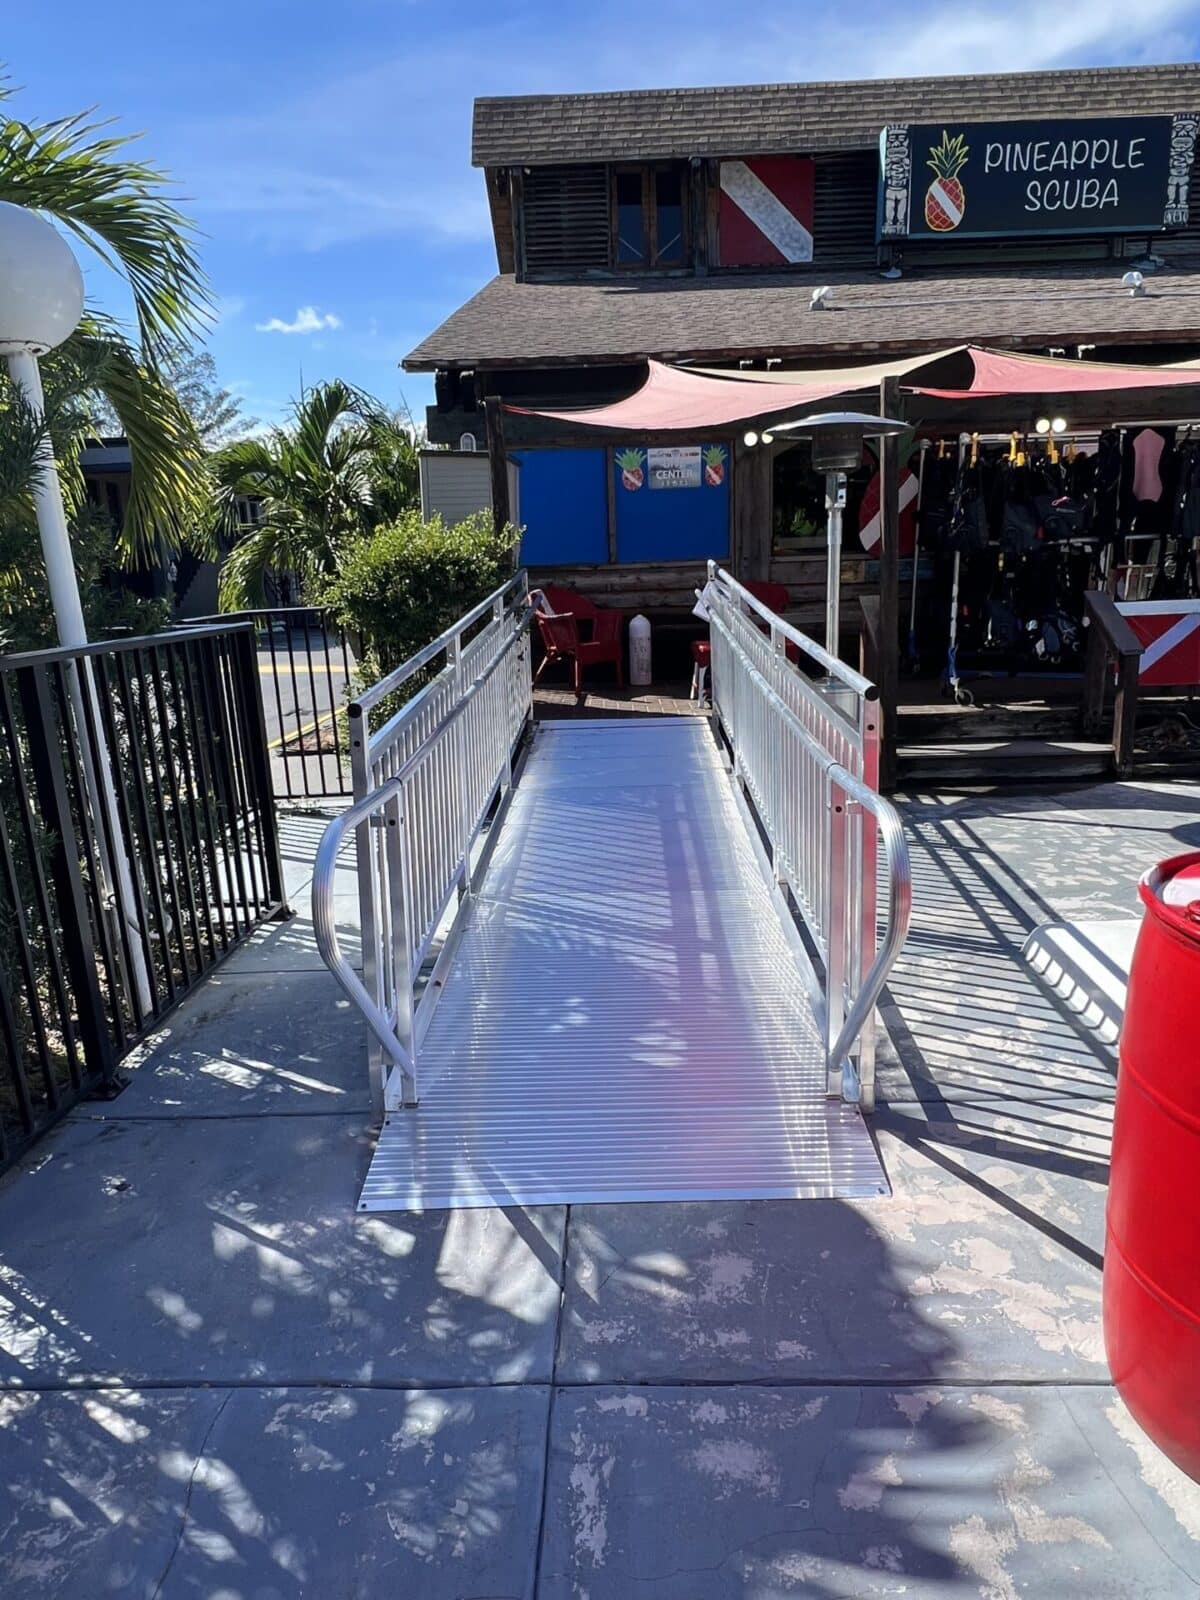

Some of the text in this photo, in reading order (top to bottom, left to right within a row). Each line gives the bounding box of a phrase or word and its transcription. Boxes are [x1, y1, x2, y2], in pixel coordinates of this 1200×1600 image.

[984, 137, 1146, 174] PINEAPPLE
[1024, 178, 1120, 212] SCUBA
[656, 470, 695, 480] CENTER
